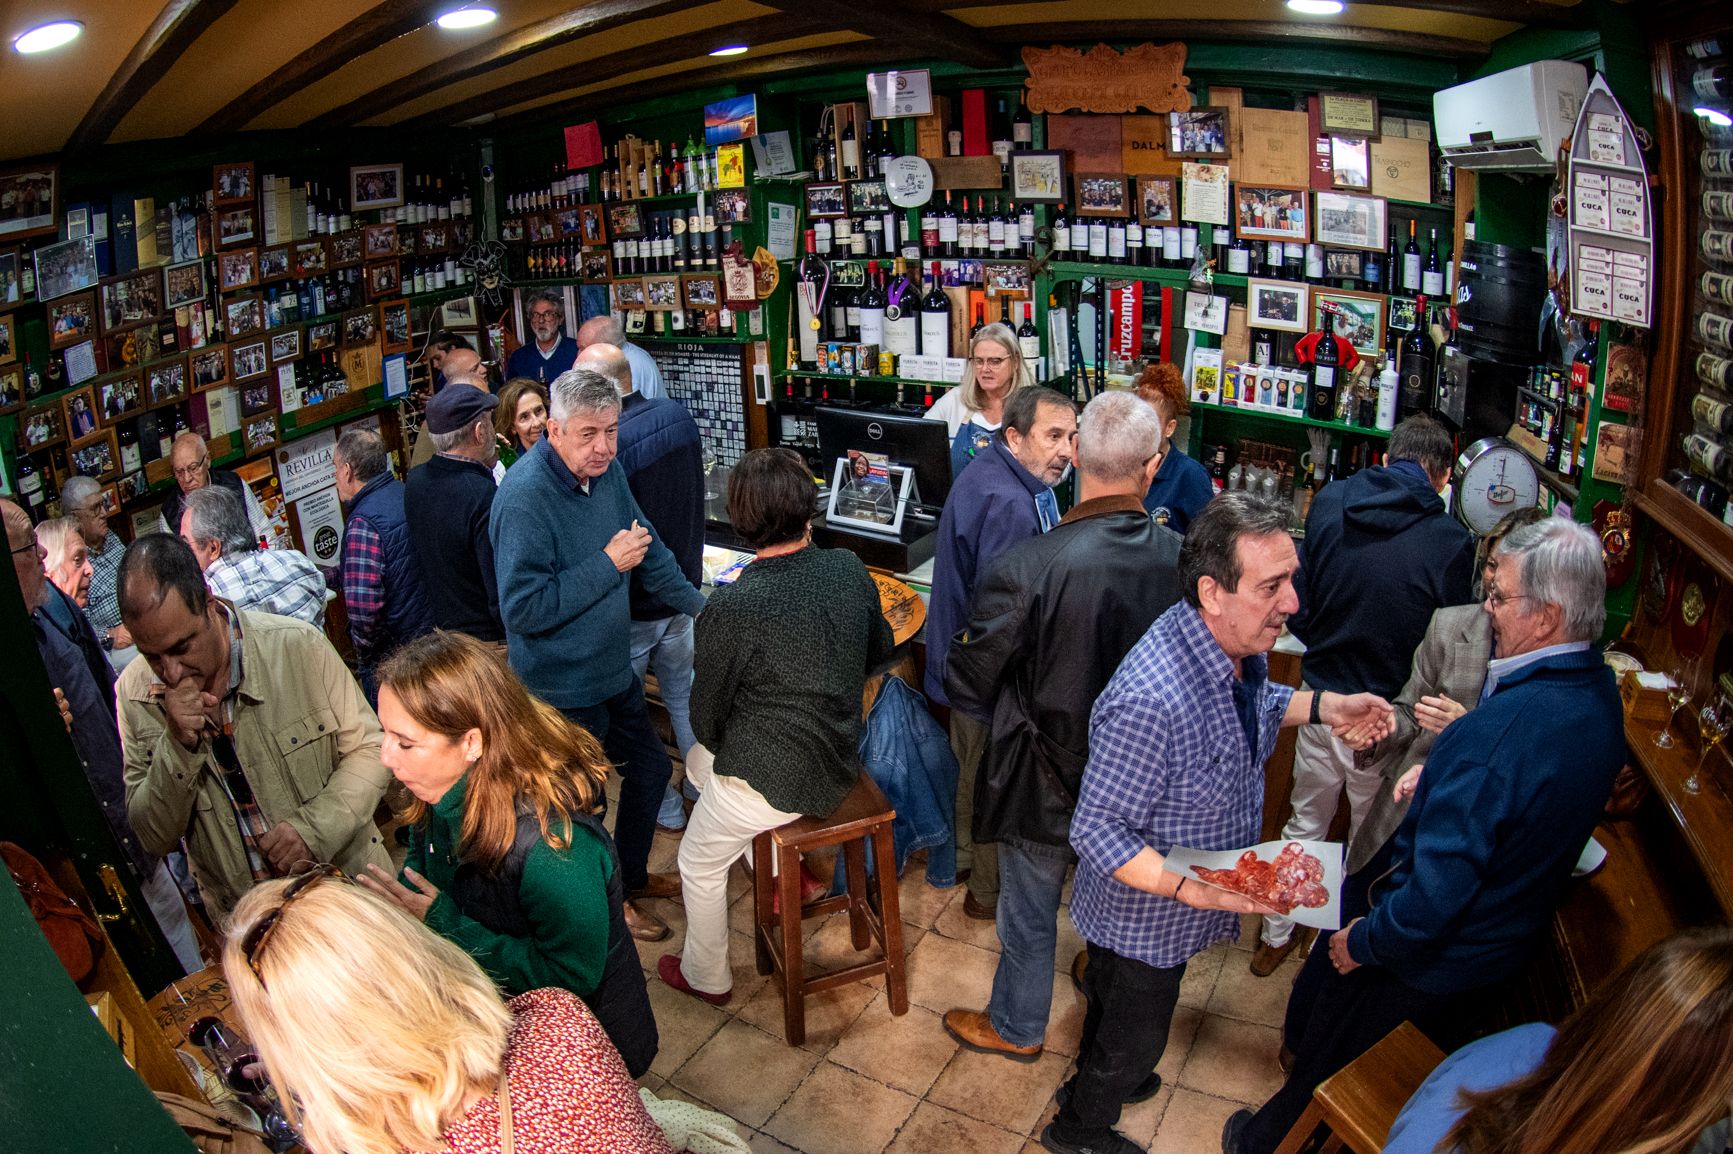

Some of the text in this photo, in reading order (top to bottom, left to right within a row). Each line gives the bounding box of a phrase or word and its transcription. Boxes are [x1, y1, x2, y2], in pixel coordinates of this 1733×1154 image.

[1581, 202, 1603, 211] CUCA
[1616, 208, 1637, 217] CUCA
[1584, 286, 1605, 296] CUCA
[1619, 293, 1640, 302] CUCA
[286, 448, 332, 477] REVILLA
[286, 486, 301, 497] MEJOR
[302, 479, 320, 490] ANCHOA
[304, 498, 316, 506] PREMIO
[316, 535, 338, 552] taste
